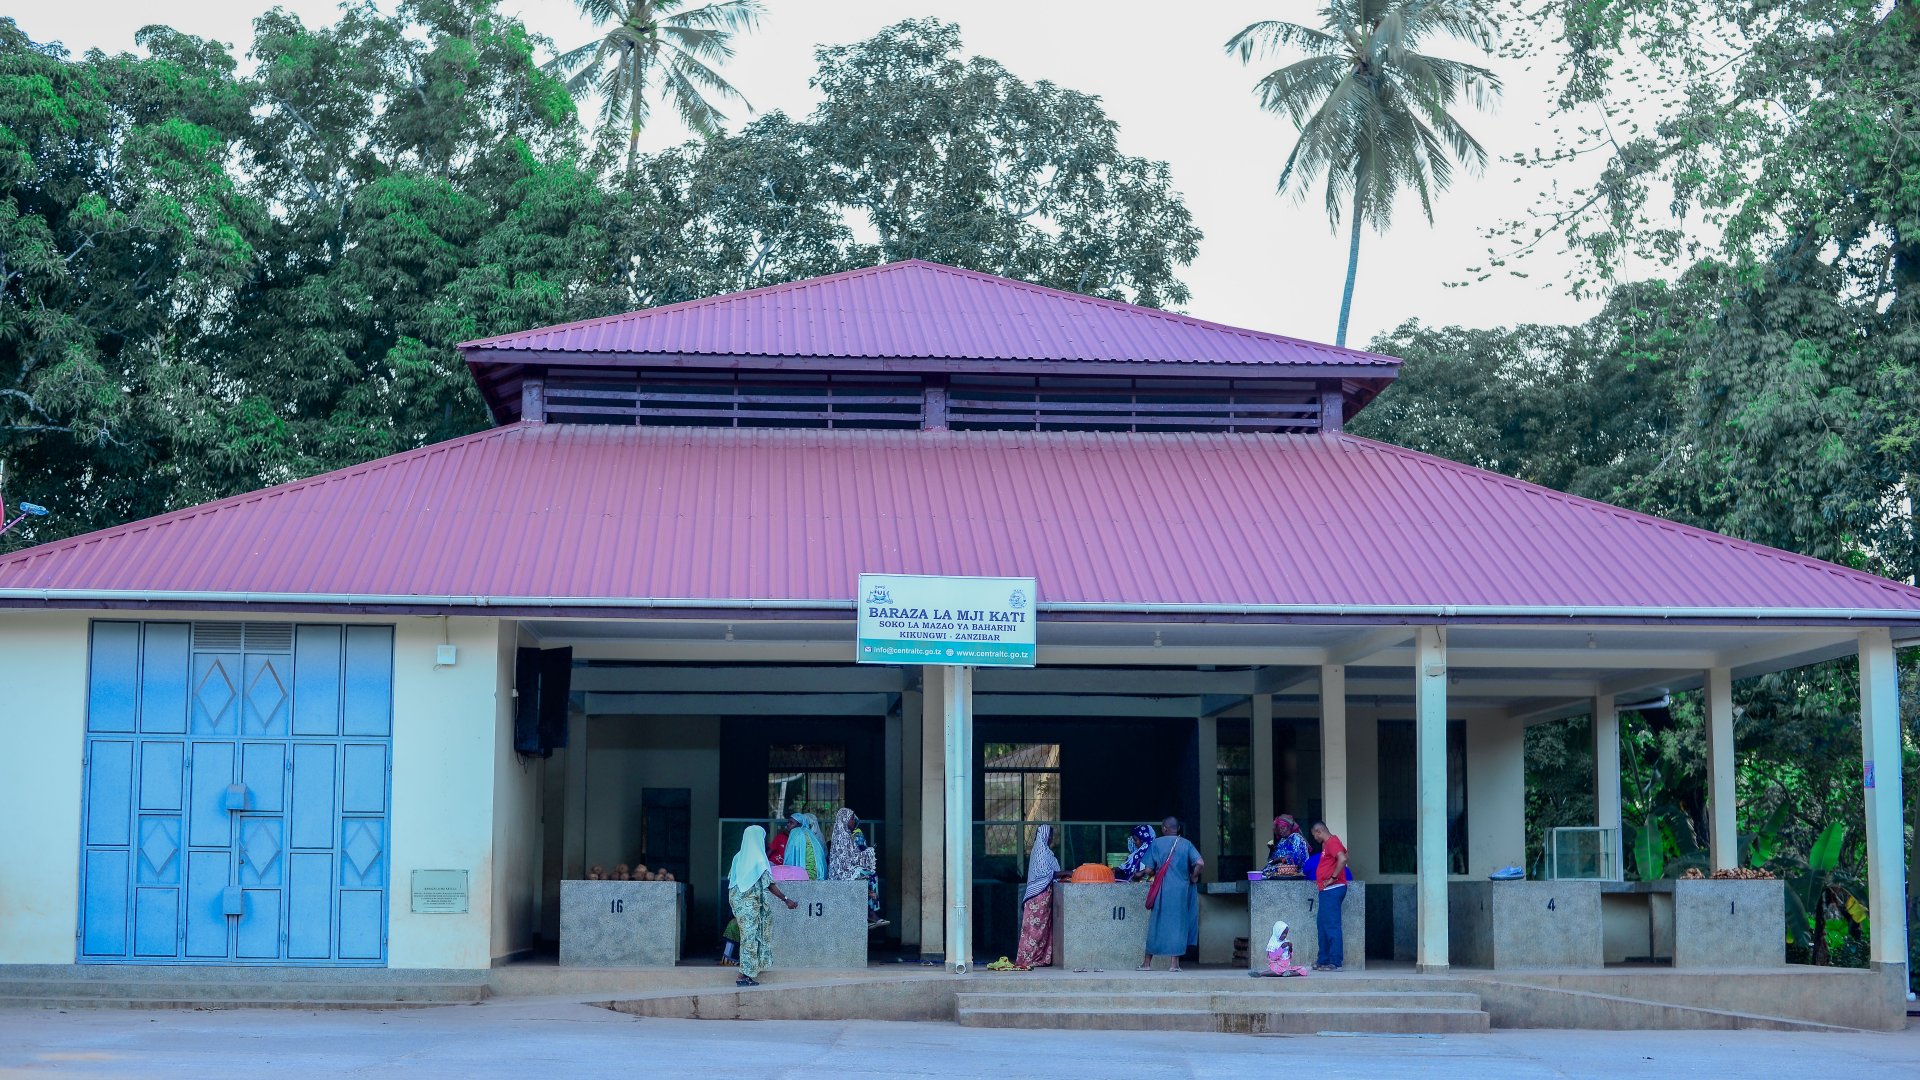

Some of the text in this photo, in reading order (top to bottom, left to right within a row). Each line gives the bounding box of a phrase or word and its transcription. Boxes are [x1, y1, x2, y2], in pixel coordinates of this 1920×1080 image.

[869, 607, 1026, 623] BARAZA LA MJI KATI
[879, 620, 1016, 632] SOKO LA MAZAO YA BAHARINI
[900, 631, 947, 640] KIKUNGWI
[955, 633, 1001, 642] ZANZIBAR
[873, 646, 942, 656] info@centraltc.go.tz
[956, 650, 1028, 659] www.centraltc.go.tz
[611, 899, 623, 913] 16
[808, 902, 823, 917] 13
[1307, 898, 1314, 912] 7
[1547, 897, 1555, 911] 4
[1112, 906, 1125, 921] 10
